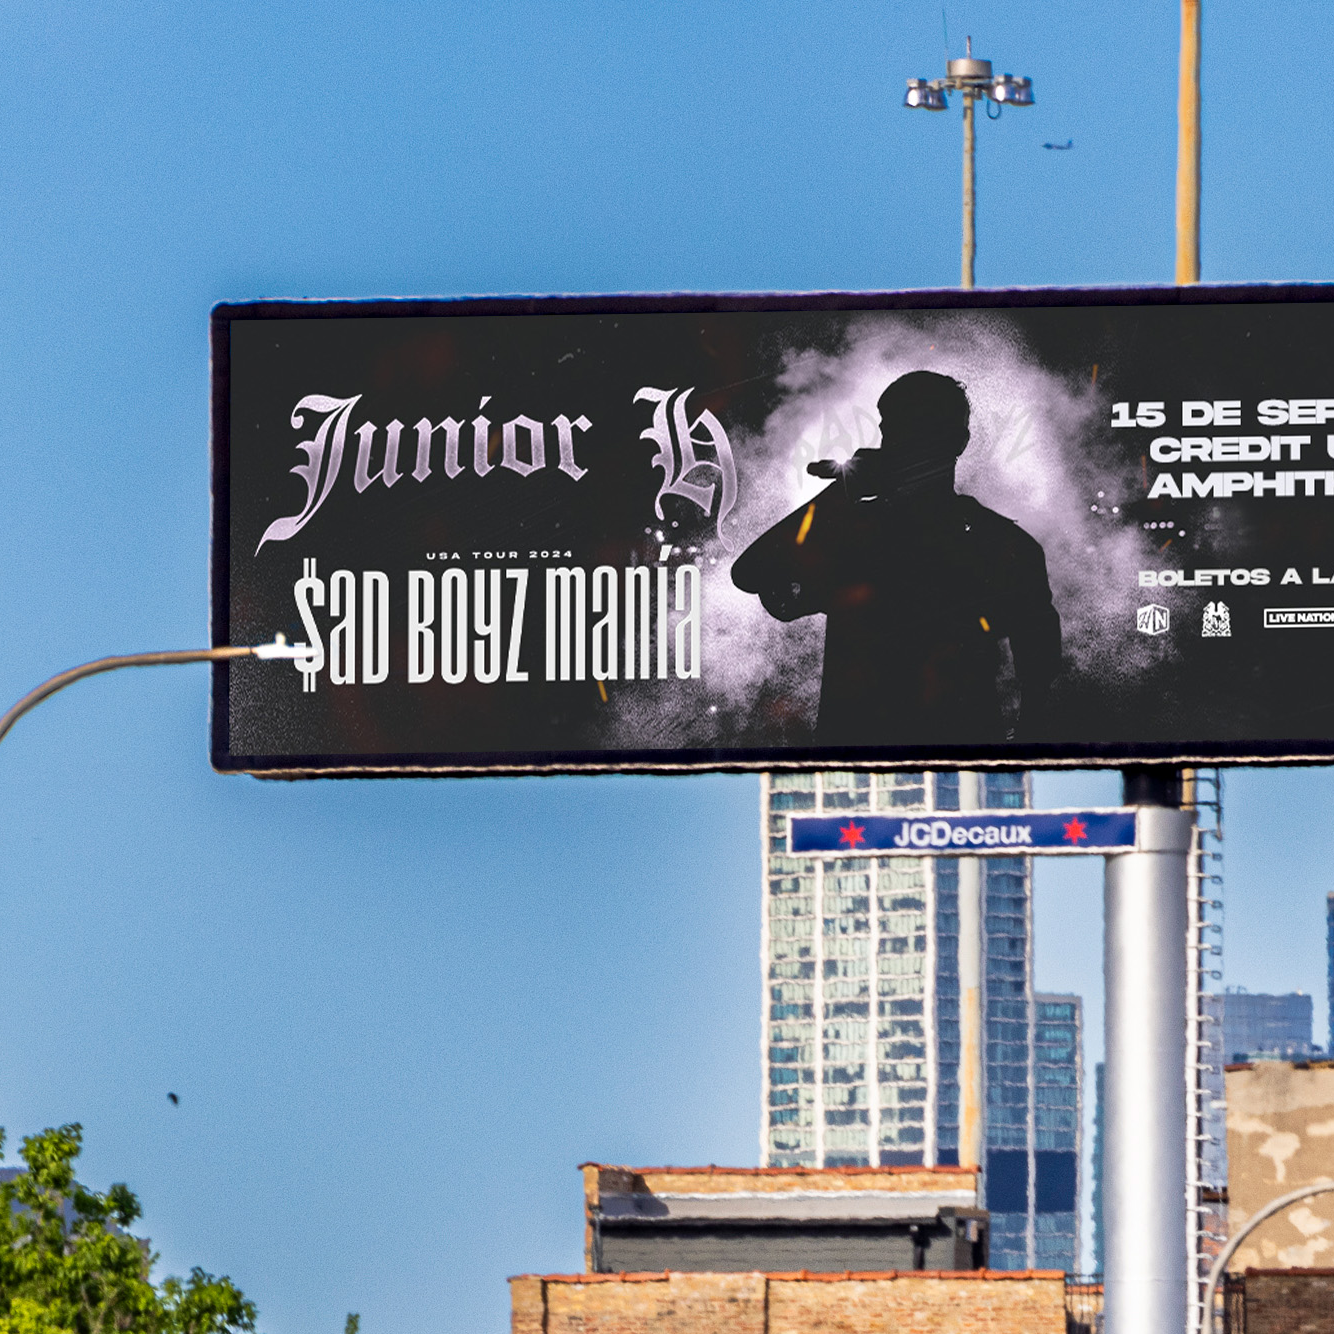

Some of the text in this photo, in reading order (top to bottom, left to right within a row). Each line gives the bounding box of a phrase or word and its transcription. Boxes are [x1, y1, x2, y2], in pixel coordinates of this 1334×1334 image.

[1111, 402, 1166, 428] 15
[1182, 401, 1241, 426] DE
[1149, 435, 1311, 463] CREDIT
[255, 394, 592, 557] Junior
[426, 550, 572, 560] USA TOUR 2024
[1137, 568, 1270, 587] BOLETOS
[1280, 567, 1303, 585] A
[1269, 613, 1296, 623] LIVE
[894, 821, 1032, 847] JCDecaux
